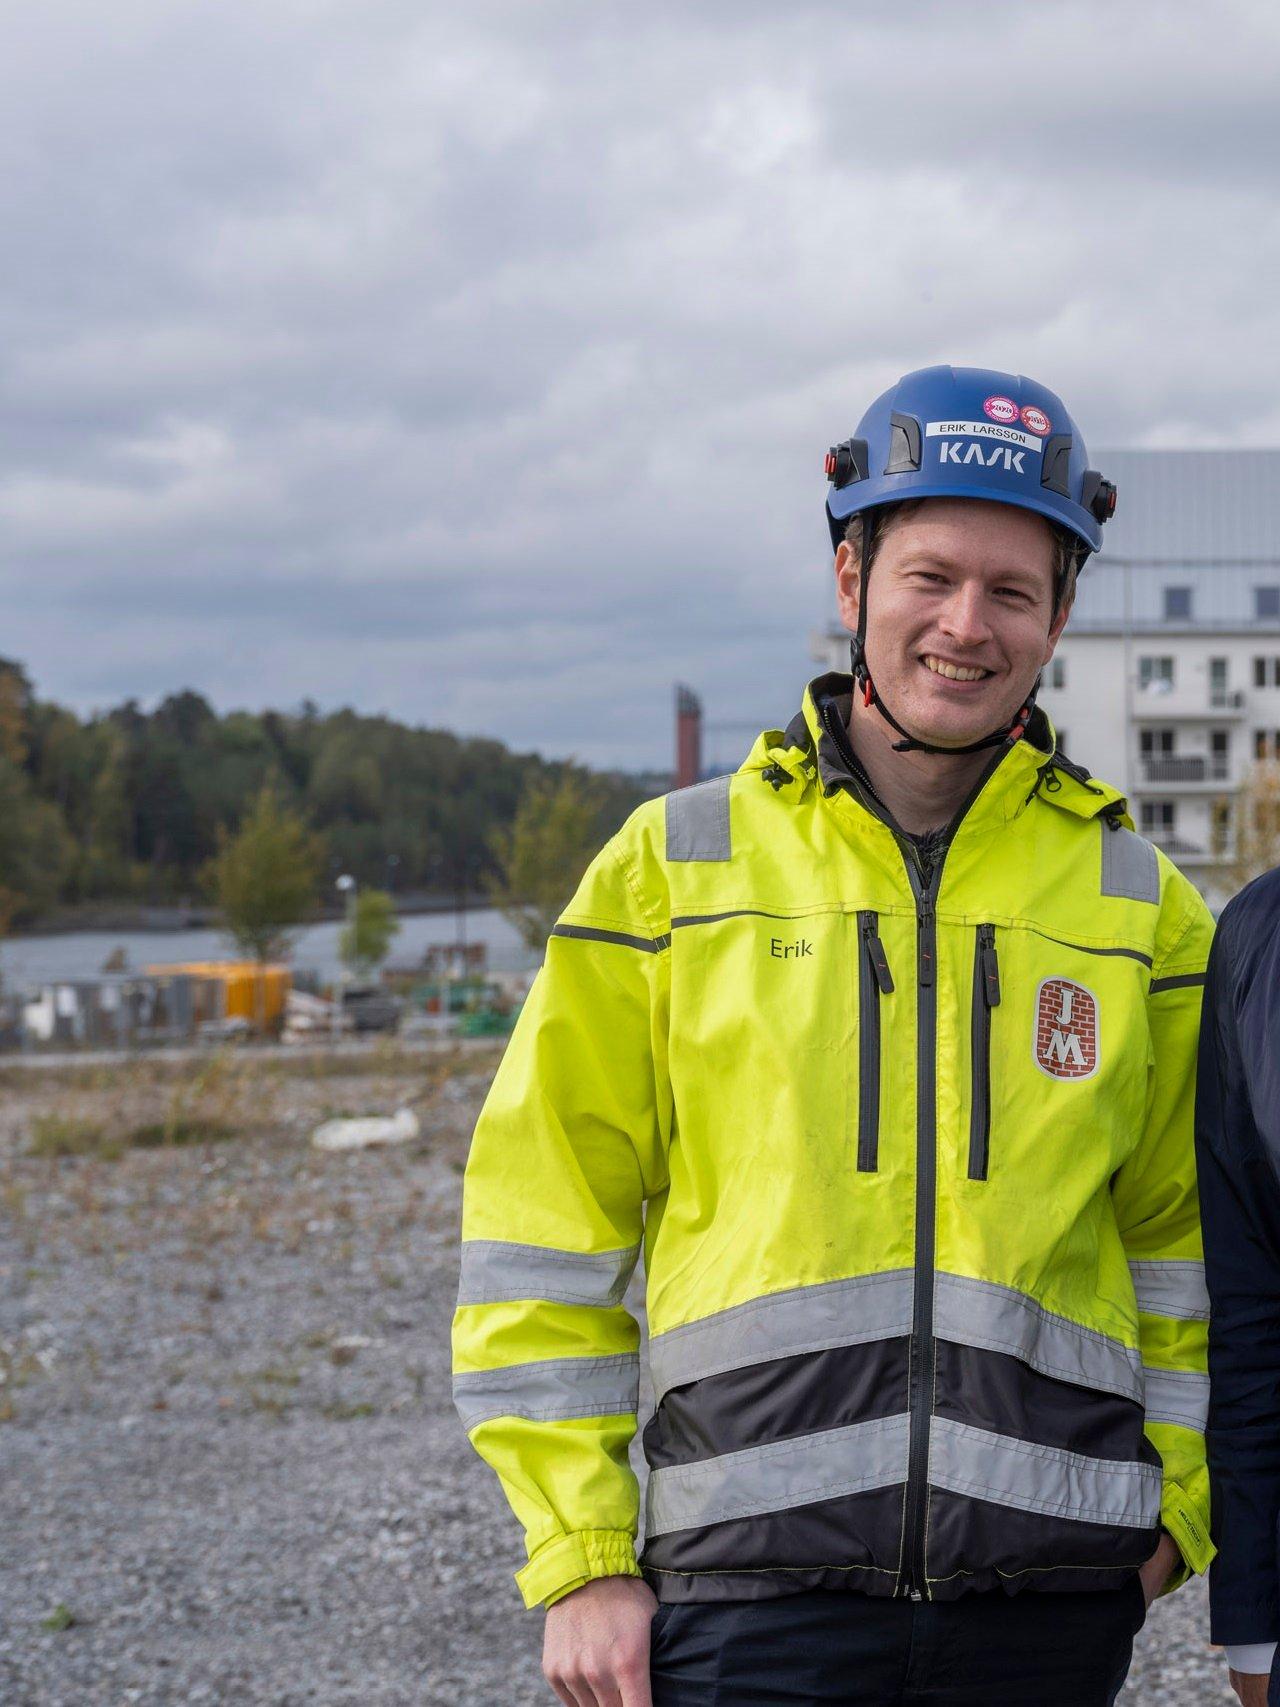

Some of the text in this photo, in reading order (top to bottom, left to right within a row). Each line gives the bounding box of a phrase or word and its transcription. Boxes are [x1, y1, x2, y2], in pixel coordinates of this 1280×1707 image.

[939, 424, 1026, 443] ERIK LARSSON
[939, 442, 1026, 474] KASK
[771, 938, 813, 959] Erik
